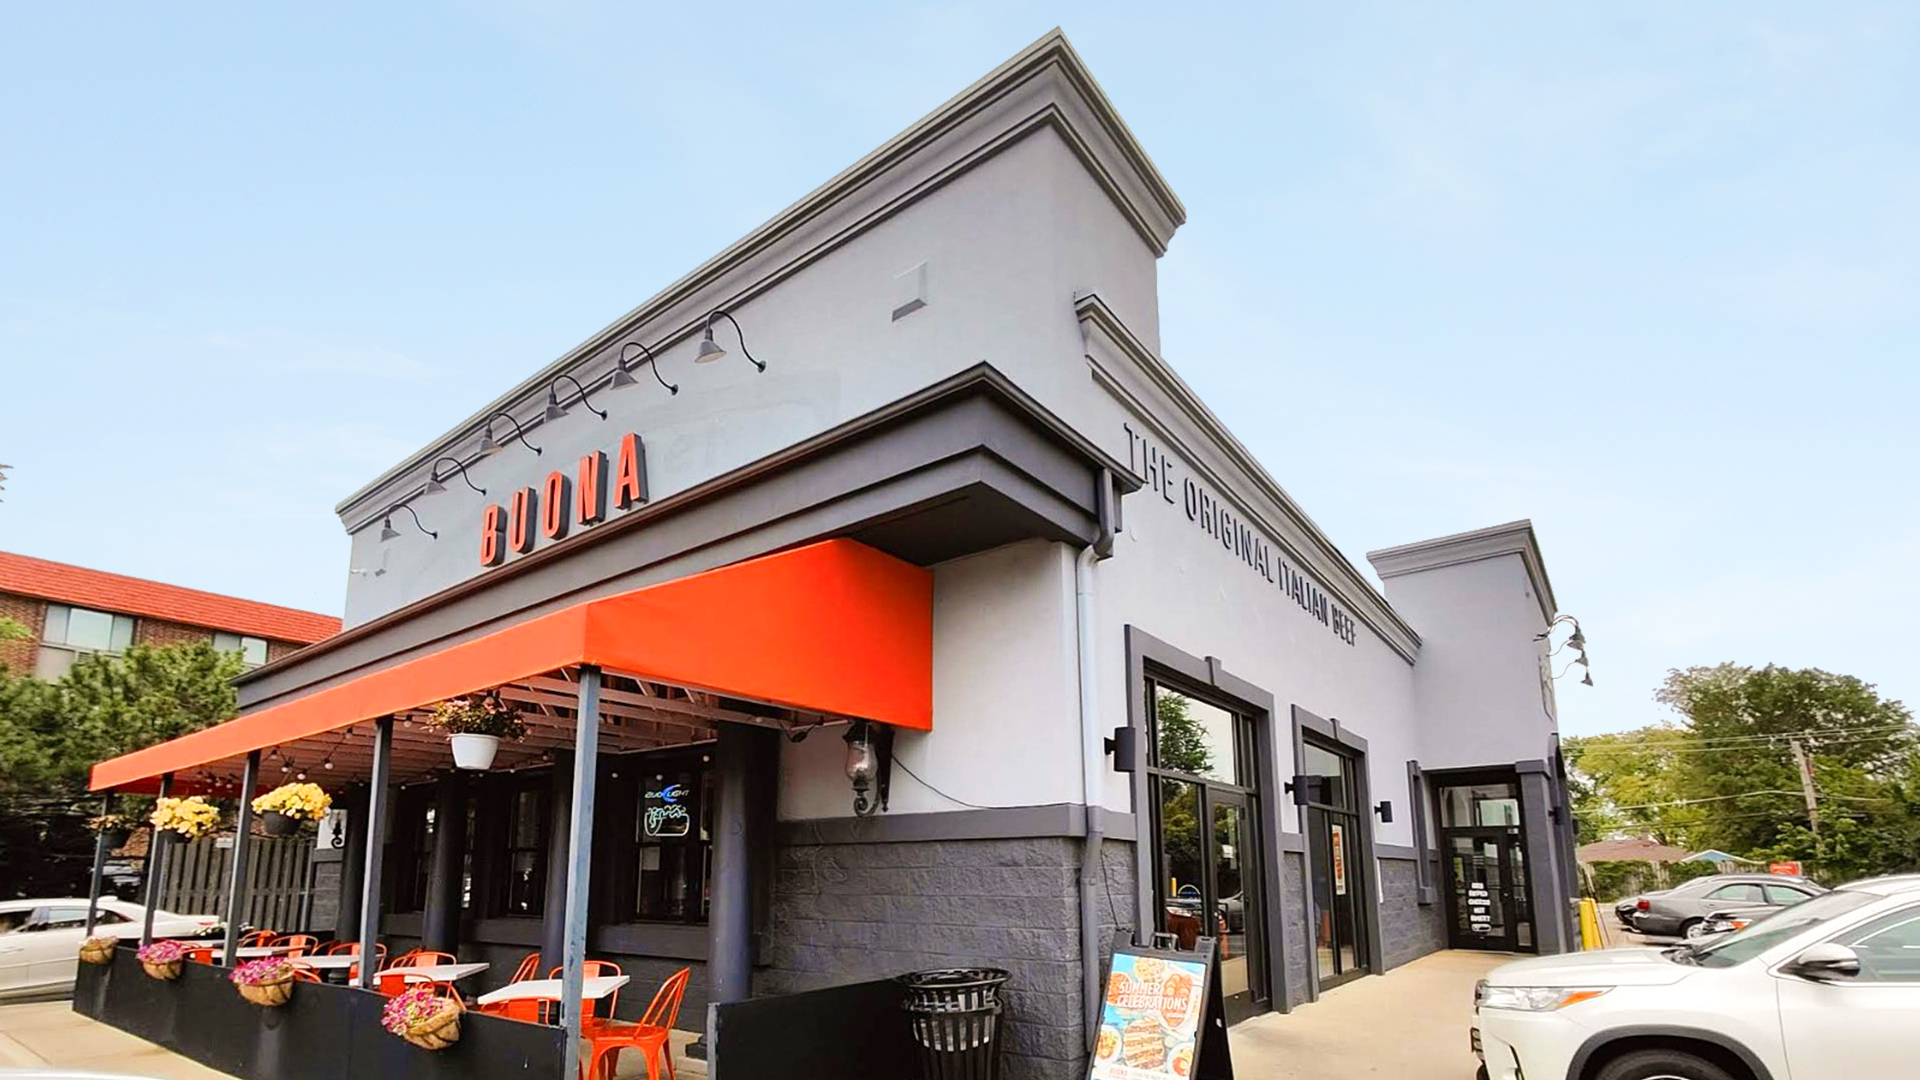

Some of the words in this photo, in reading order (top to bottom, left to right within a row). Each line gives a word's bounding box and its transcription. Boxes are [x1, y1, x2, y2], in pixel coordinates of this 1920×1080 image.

[480, 432, 649, 567] BUONA
[1124, 422, 1175, 504] THE
[1184, 477, 1274, 583] ORIGINAL
[1278, 557, 1329, 626] ITALIAN
[1331, 603, 1356, 647] BEEF
[667, 790, 690, 798] LIGHT
[1119, 982, 1161, 995] SUMMER
[1117, 995, 1188, 1011] CELEBRATIONS
